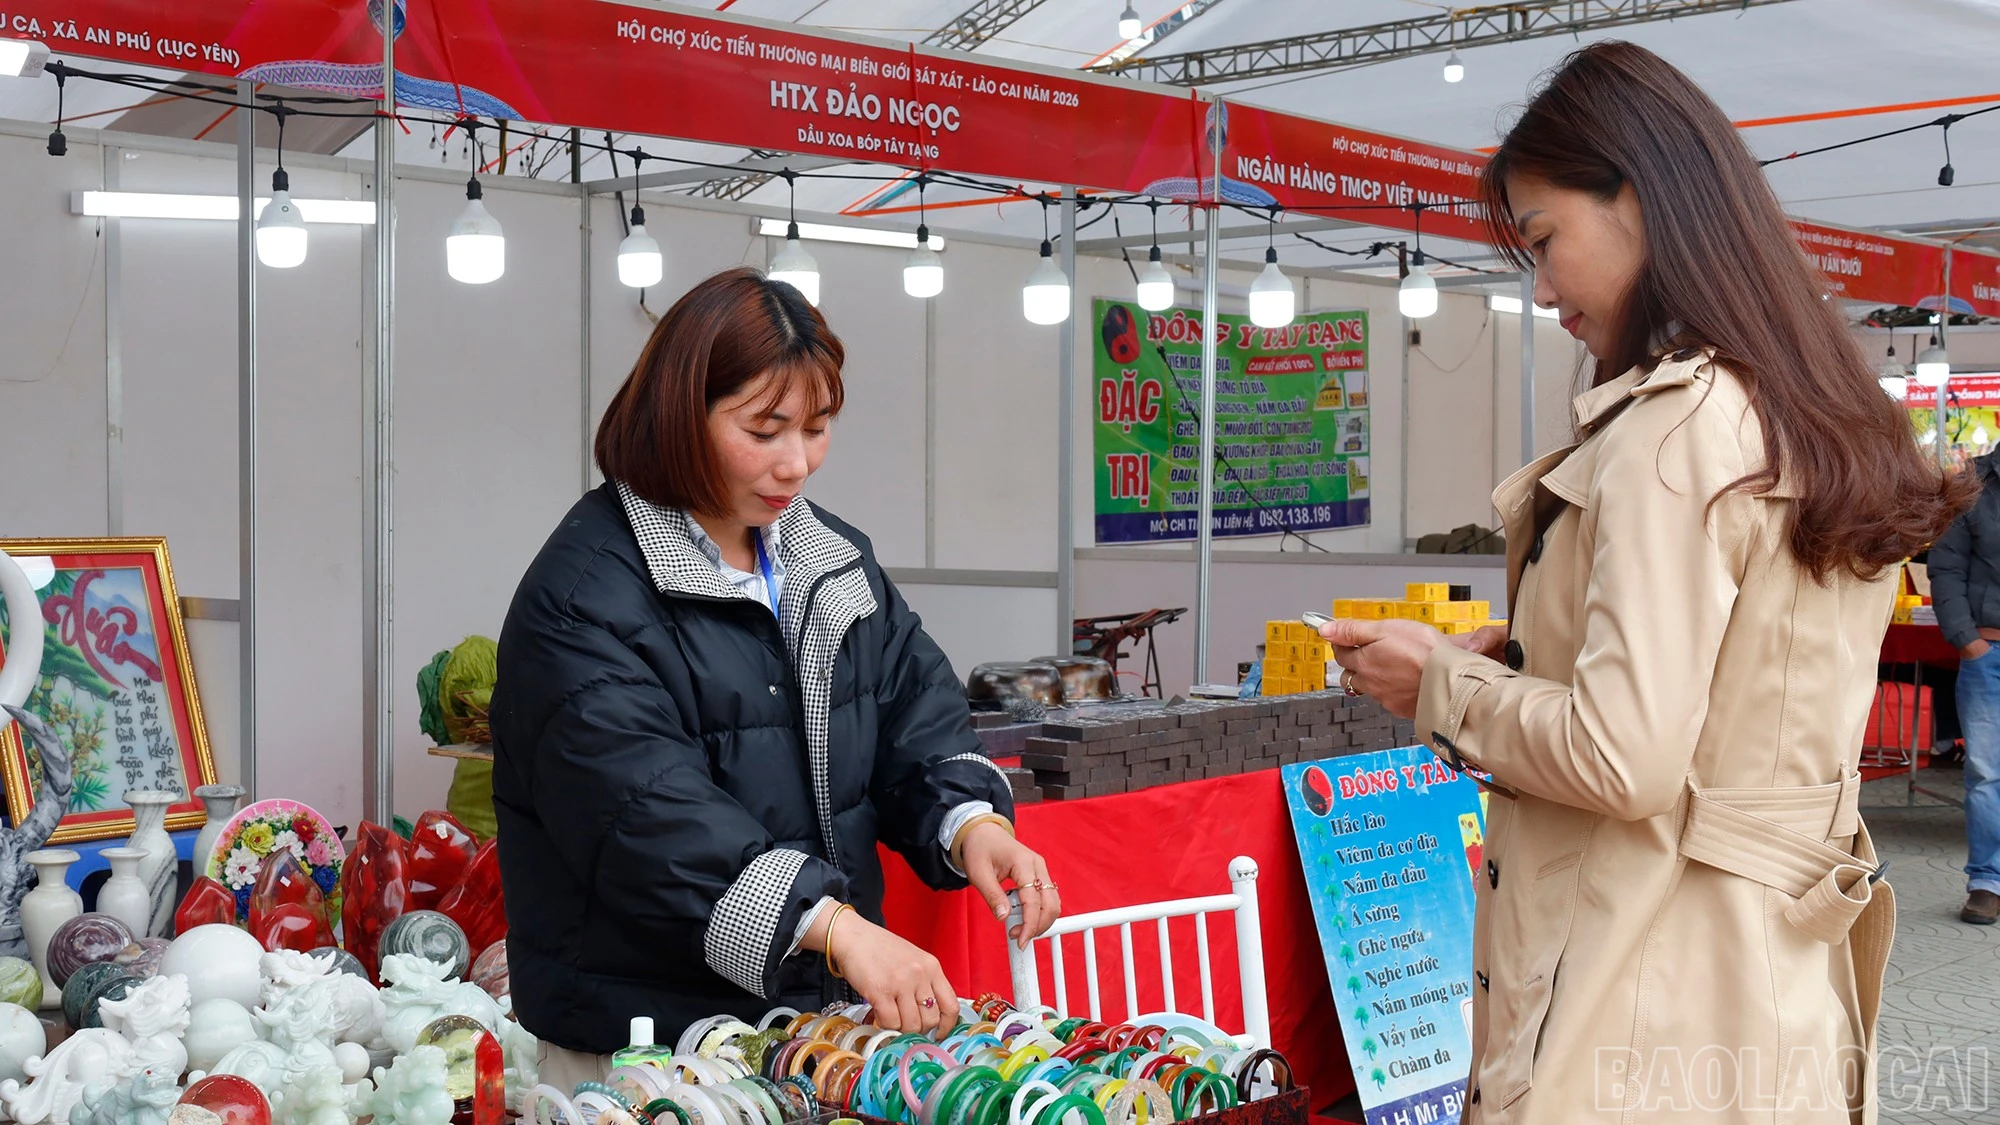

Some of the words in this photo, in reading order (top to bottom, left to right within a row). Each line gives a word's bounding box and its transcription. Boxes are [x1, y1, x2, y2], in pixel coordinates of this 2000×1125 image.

[12, 15, 47, 38] CẠ,
[52, 20, 79, 40] XÃ
[84, 27, 111, 45] AN
[116, 31, 151, 51] PHÚ
[157, 38, 197, 59] (LỤC
[201, 43, 240, 69] YÊN)
[617, 19, 645, 43] HỘI
[650, 26, 686, 50] CHỢ
[690, 31, 722, 52] XÚC
[726, 34, 755, 57] TIẾN
[759, 43, 817, 66] THƯƠNG
[821, 53, 846, 74] MẠI
[850, 56, 878, 76] BIÊN
[881, 63, 911, 81] GIỚI
[915, 66, 936, 85] BÁT
[940, 71, 964, 90] XÁT
[972, 77, 997, 94] LÀO
[1000, 82, 1020, 98] CAI
[1023, 85, 1050, 102] NĂM
[1052, 90, 1079, 107] 2026
[770, 80, 819, 113] HTX
[826, 82, 882, 121] ĐẢO
[889, 97, 961, 137] NGỌC
[797, 122, 824, 146] DẦU
[827, 132, 854, 149] XOA
[857, 133, 882, 152] BÓP
[883, 137, 905, 154] TÂY
[907, 142, 940, 161] TẠNG
[1332, 137, 1349, 155] HỘI
[1350, 141, 1370, 159] CHỢ
[1370, 142, 1389, 160] XÚC
[1390, 146, 1406, 163] TIẾN
[1407, 152, 1440, 170] THƯƠNG
[1441, 158, 1455, 175] MẠI
[1456, 160, 1473, 177] BIÊN
[1237, 154, 1286, 186] NGÂN
[1289, 162, 1336, 194] HÀNG
[1340, 175, 1381, 202] TMCP
[1385, 180, 1414, 213] VIỆT
[1417, 189, 1449, 214] NAM
[1821, 252, 1839, 273] VĂN
[1841, 256, 1862, 277] DƯỚI
[1973, 282, 1988, 299] VĂN
[1238, 326, 1255, 349] Y
[1307, 319, 1364, 350] TẠNG
[1100, 369, 1162, 433] ĐẶC
[1172, 445, 1194, 459] ĐAU
[1106, 454, 1149, 507] TRỊ
[1170, 467, 1191, 482] ĐAU
[1170, 518, 1187, 532] CHI
[1223, 513, 1242, 529] LIÊN
[125, 770, 144, 785] gia
[1338, 767, 1398, 799] ĐÔNG
[1401, 765, 1416, 789] Y
[1330, 812, 1360, 836] Hắc
[1363, 811, 1386, 830] lào
[1336, 844, 1374, 867] Viêm
[1378, 842, 1394, 858] da
[1397, 838, 1414, 855] cơ
[1417, 833, 1438, 855] địa
[1344, 870, 1378, 897] Nấm
[1381, 871, 1398, 889] da
[1401, 861, 1427, 884] đầu
[1351, 902, 1362, 927] Á
[1366, 903, 1400, 925] sừng
[1358, 934, 1387, 957] Ghẻ
[1391, 928, 1425, 950] ngứa
[1364, 962, 1402, 989] Nghẻ
[1406, 955, 1440, 978] nước
[1372, 993, 1407, 1019] Nấm
[1411, 987, 1449, 1008] móng
[1450, 979, 1469, 998] tay
[1379, 1023, 1406, 1049] Vẩy
[1410, 1015, 1437, 1040] nến
[1388, 1055, 1431, 1080] Chàm
[1434, 1048, 1451, 1066] da
[1414, 1101, 1439, 1125] Mr
